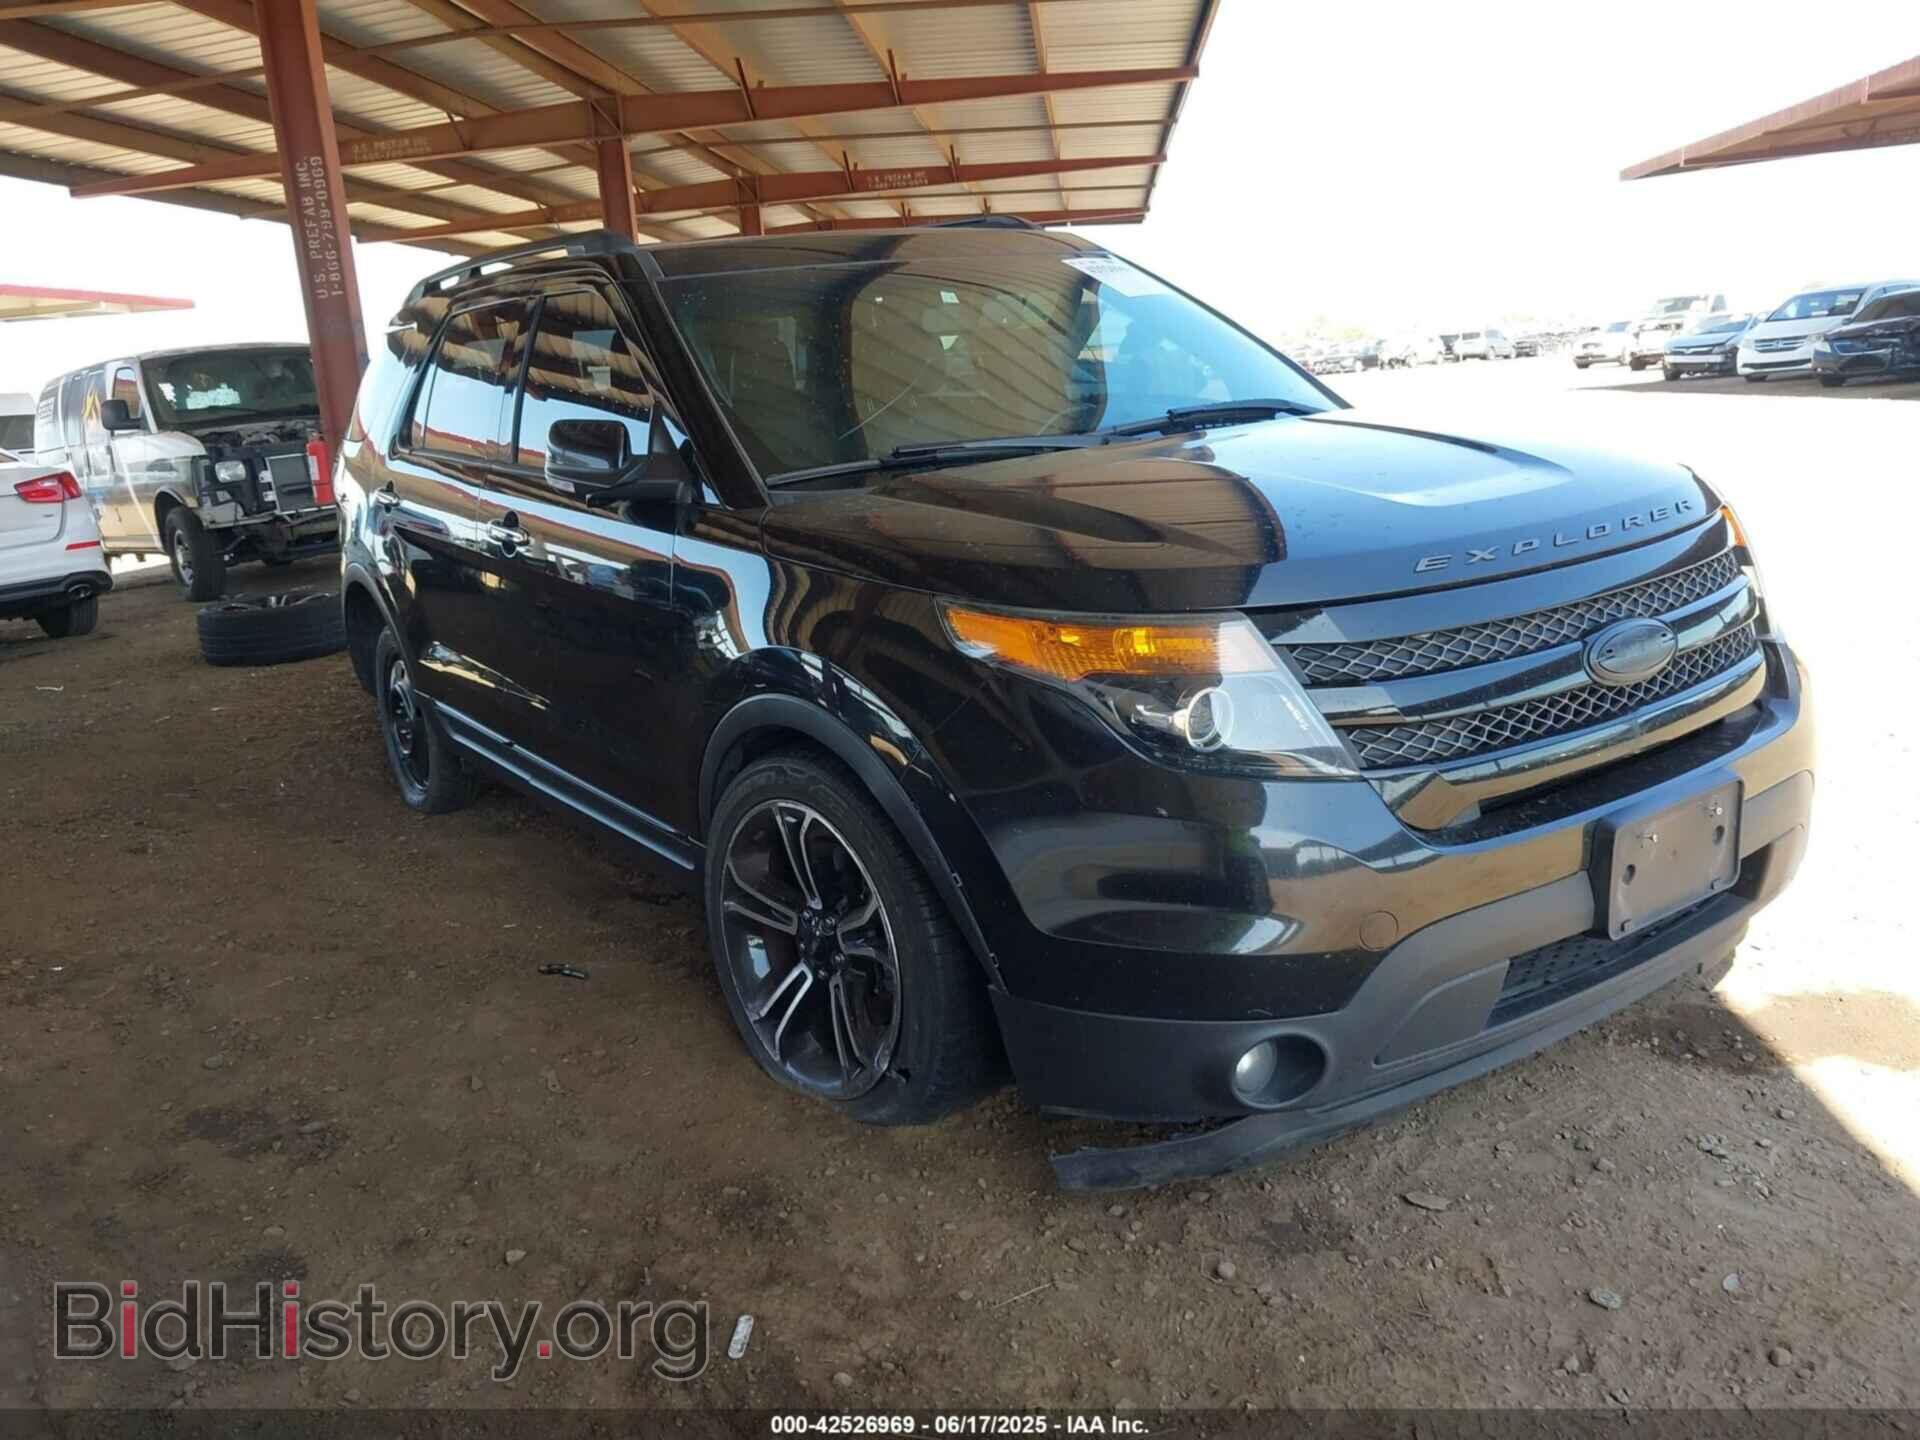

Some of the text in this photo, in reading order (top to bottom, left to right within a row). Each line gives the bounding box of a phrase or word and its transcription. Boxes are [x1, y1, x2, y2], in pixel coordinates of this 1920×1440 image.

[302, 196, 323, 259] PREFAB
[314, 268, 329, 299] U.S.
[1413, 499, 1693, 573] EXPLORER
